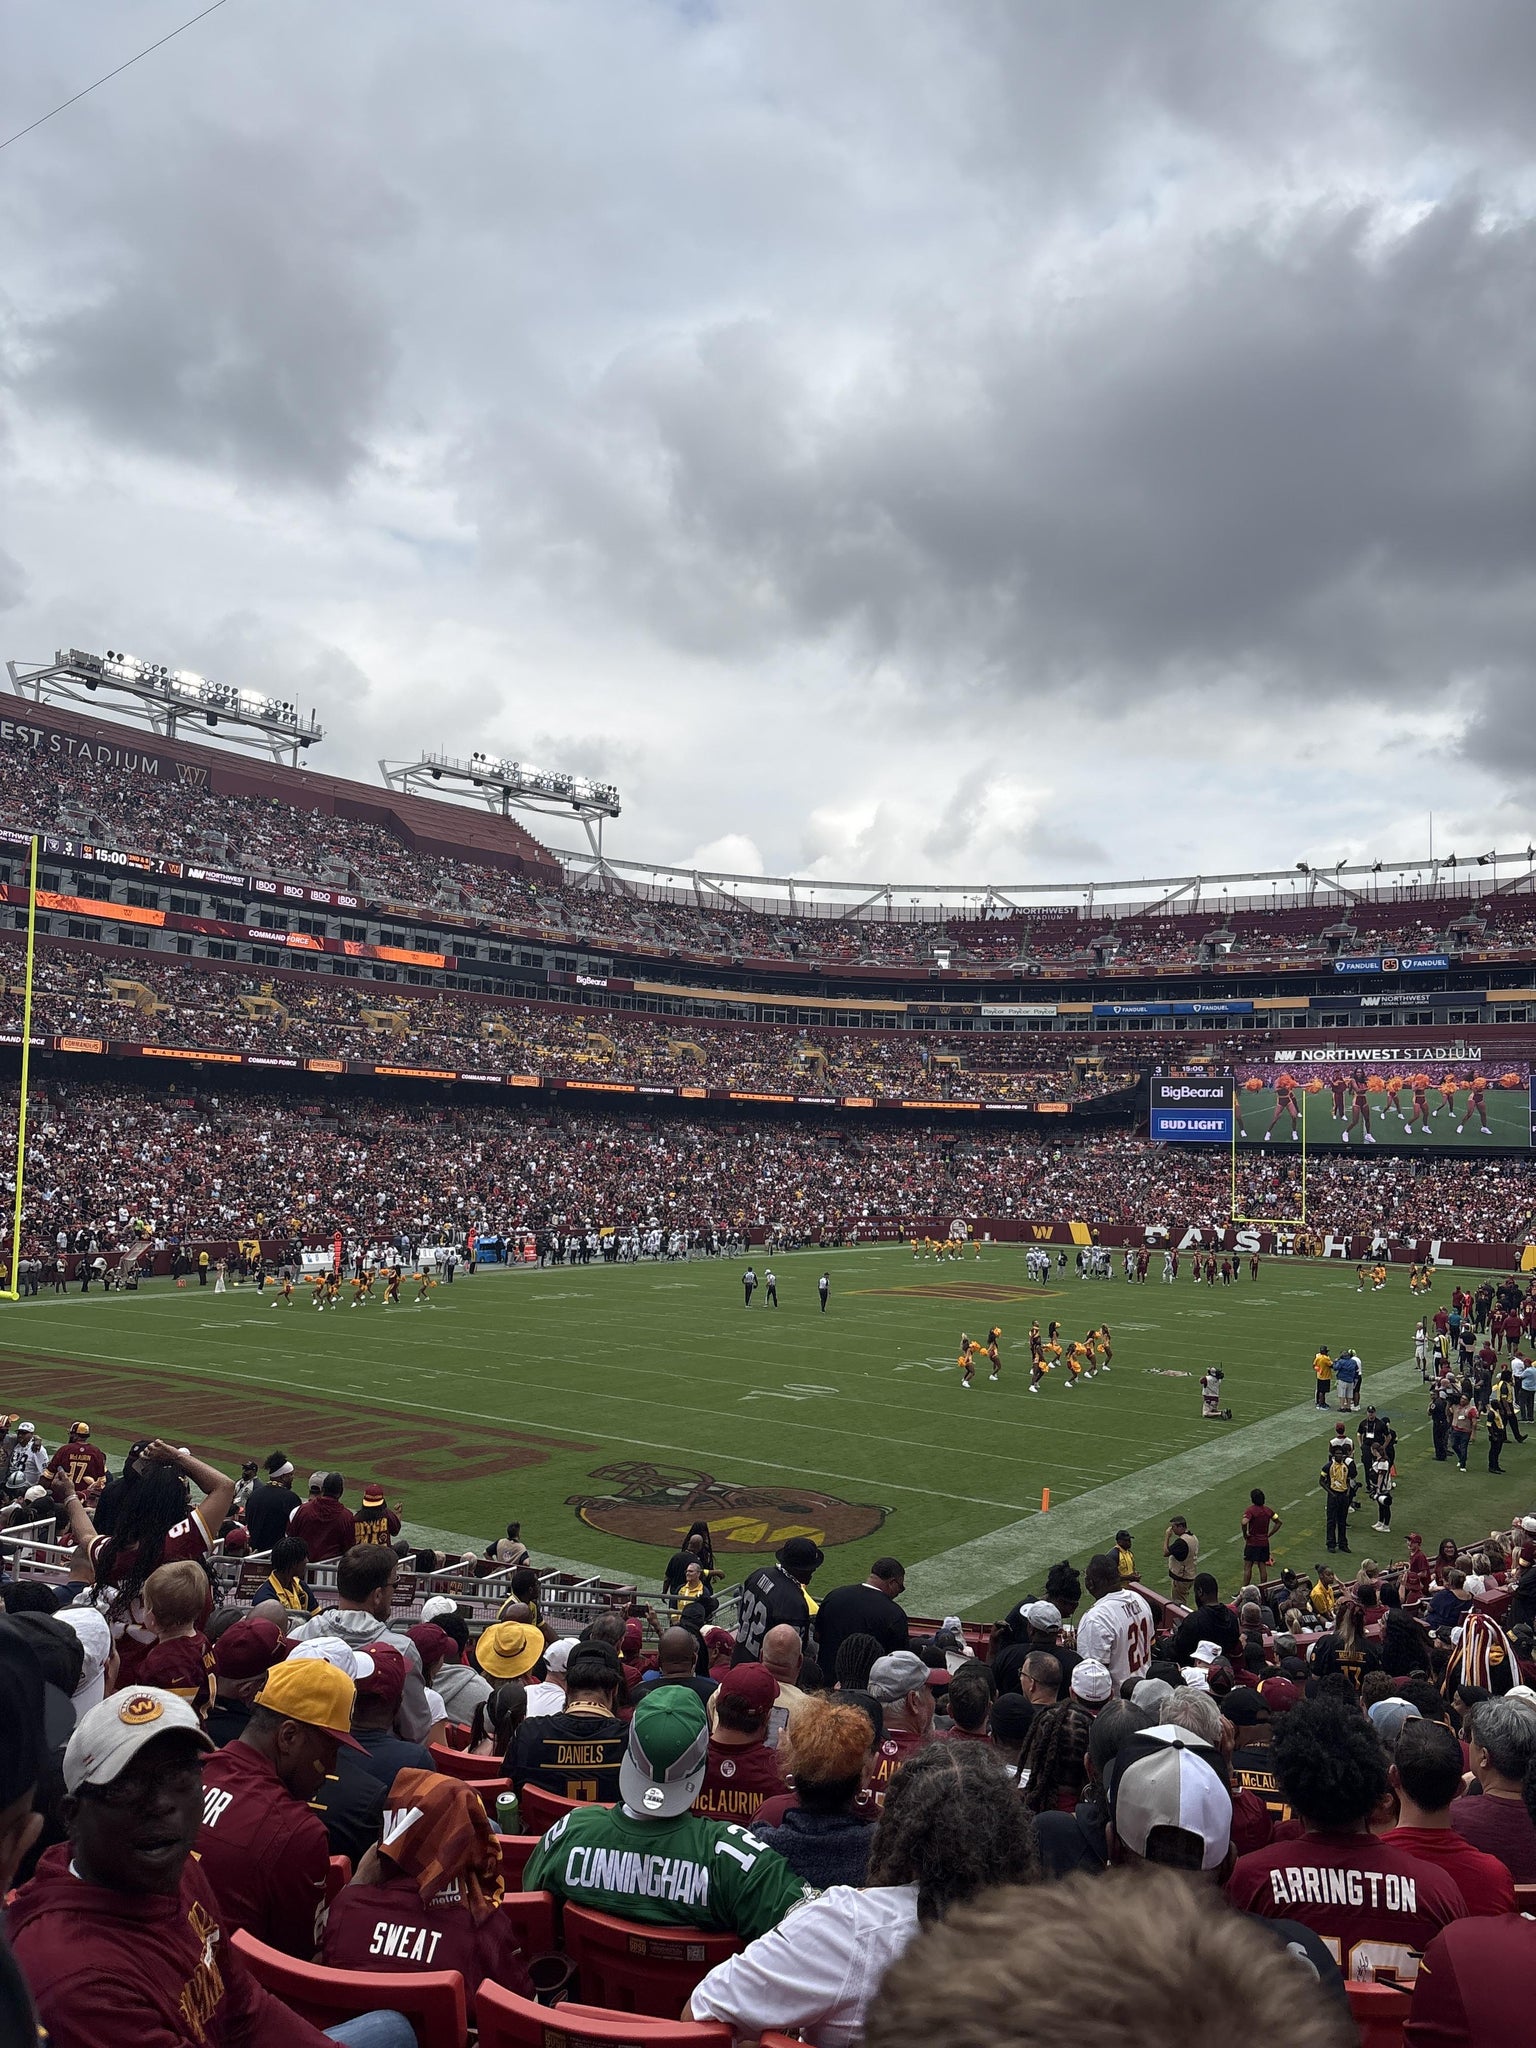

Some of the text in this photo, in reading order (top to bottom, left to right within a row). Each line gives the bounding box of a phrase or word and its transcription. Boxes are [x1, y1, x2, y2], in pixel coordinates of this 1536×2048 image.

[50, 735, 158, 775] STADIUM
[66, 842, 73, 851] 3
[95, 849, 127, 865] 15:00
[158, 861, 165, 869] 7
[205, 870, 245, 883] NORTHWEST
[256, 880, 277, 892] BDO
[284, 885, 304, 898] BDO
[311, 890, 331, 903] BDO
[338, 895, 358, 908] BDO
[1016, 907, 1075, 915] NORTHWEST
[249, 930, 309, 945] COMMAND FORCE
[1385, 960, 1396, 969] 25
[1413, 959, 1447, 968] FANDUEL
[576, 975, 608, 987] BigBear.ai
[983, 1007, 1055, 1016] Paycor Paycor Paycor
[1274, 1047, 1482, 1061] NW NORTHWEST STADIUM
[248, 1057, 297, 1067] COMMAND FORCE
[1161, 1086, 1224, 1100] BigBear.ai
[1160, 1120, 1224, 1130] BUD LIGHT
[737, 1383, 840, 1401] 10
[69, 1462, 88, 1483] 17
[1127, 1617, 1149, 1673] 21
[557, 1744, 604, 1764] DANIELS
[565, 1846, 709, 1907] CUNNINGHAM
[1270, 1867, 1417, 1913] ARRINGTON
[369, 1921, 443, 1964] SWEAT
